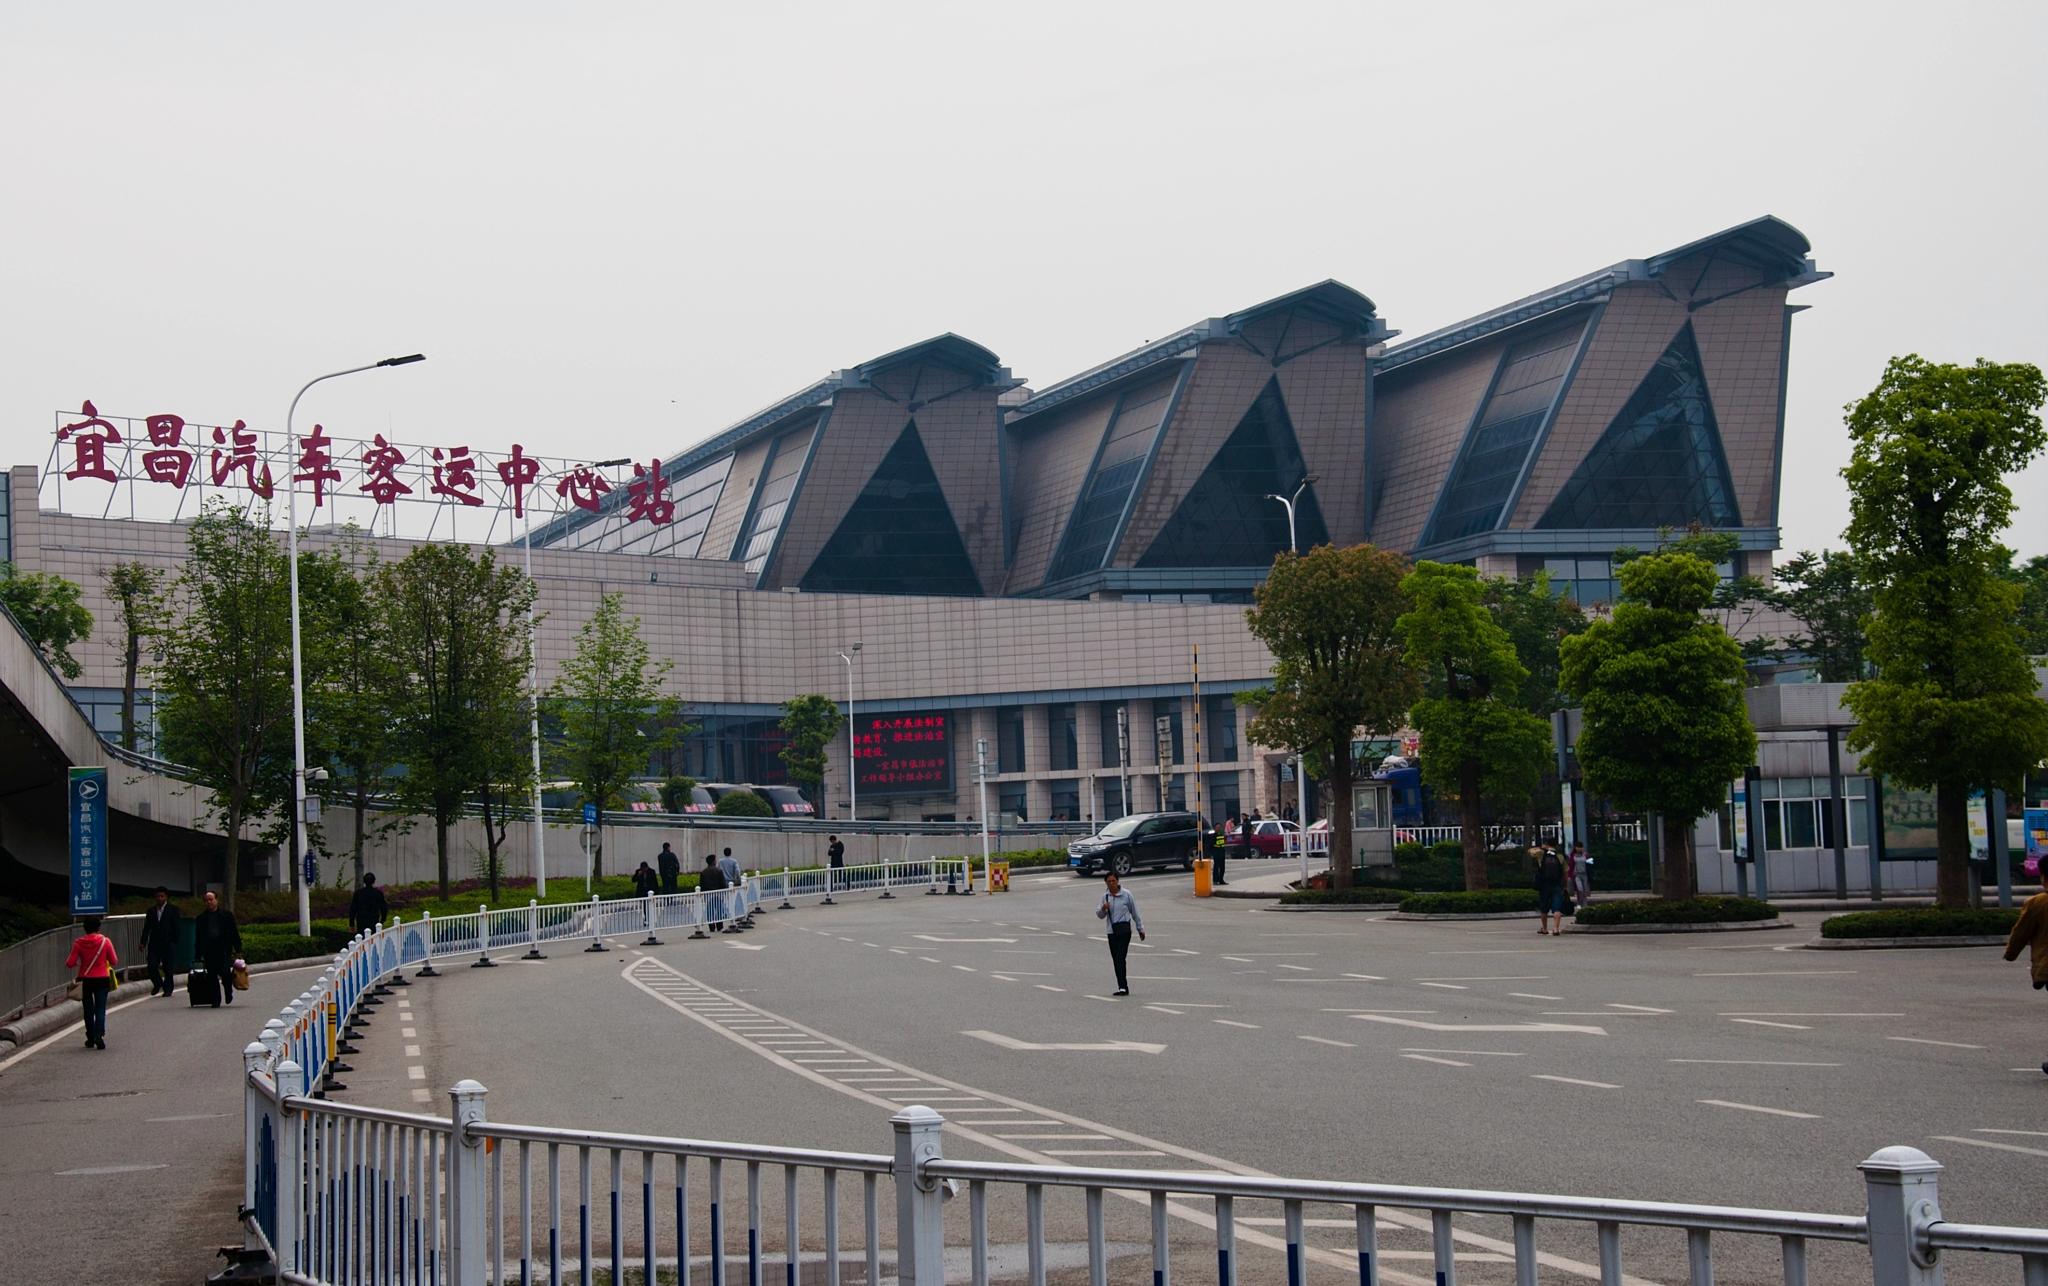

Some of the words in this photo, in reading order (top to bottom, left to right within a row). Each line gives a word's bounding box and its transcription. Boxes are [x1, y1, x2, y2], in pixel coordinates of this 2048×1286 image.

[57, 400, 675, 526] 宜昌汽车客运中心站
[80, 802, 92, 901] 宜昌汽车客运中心站
